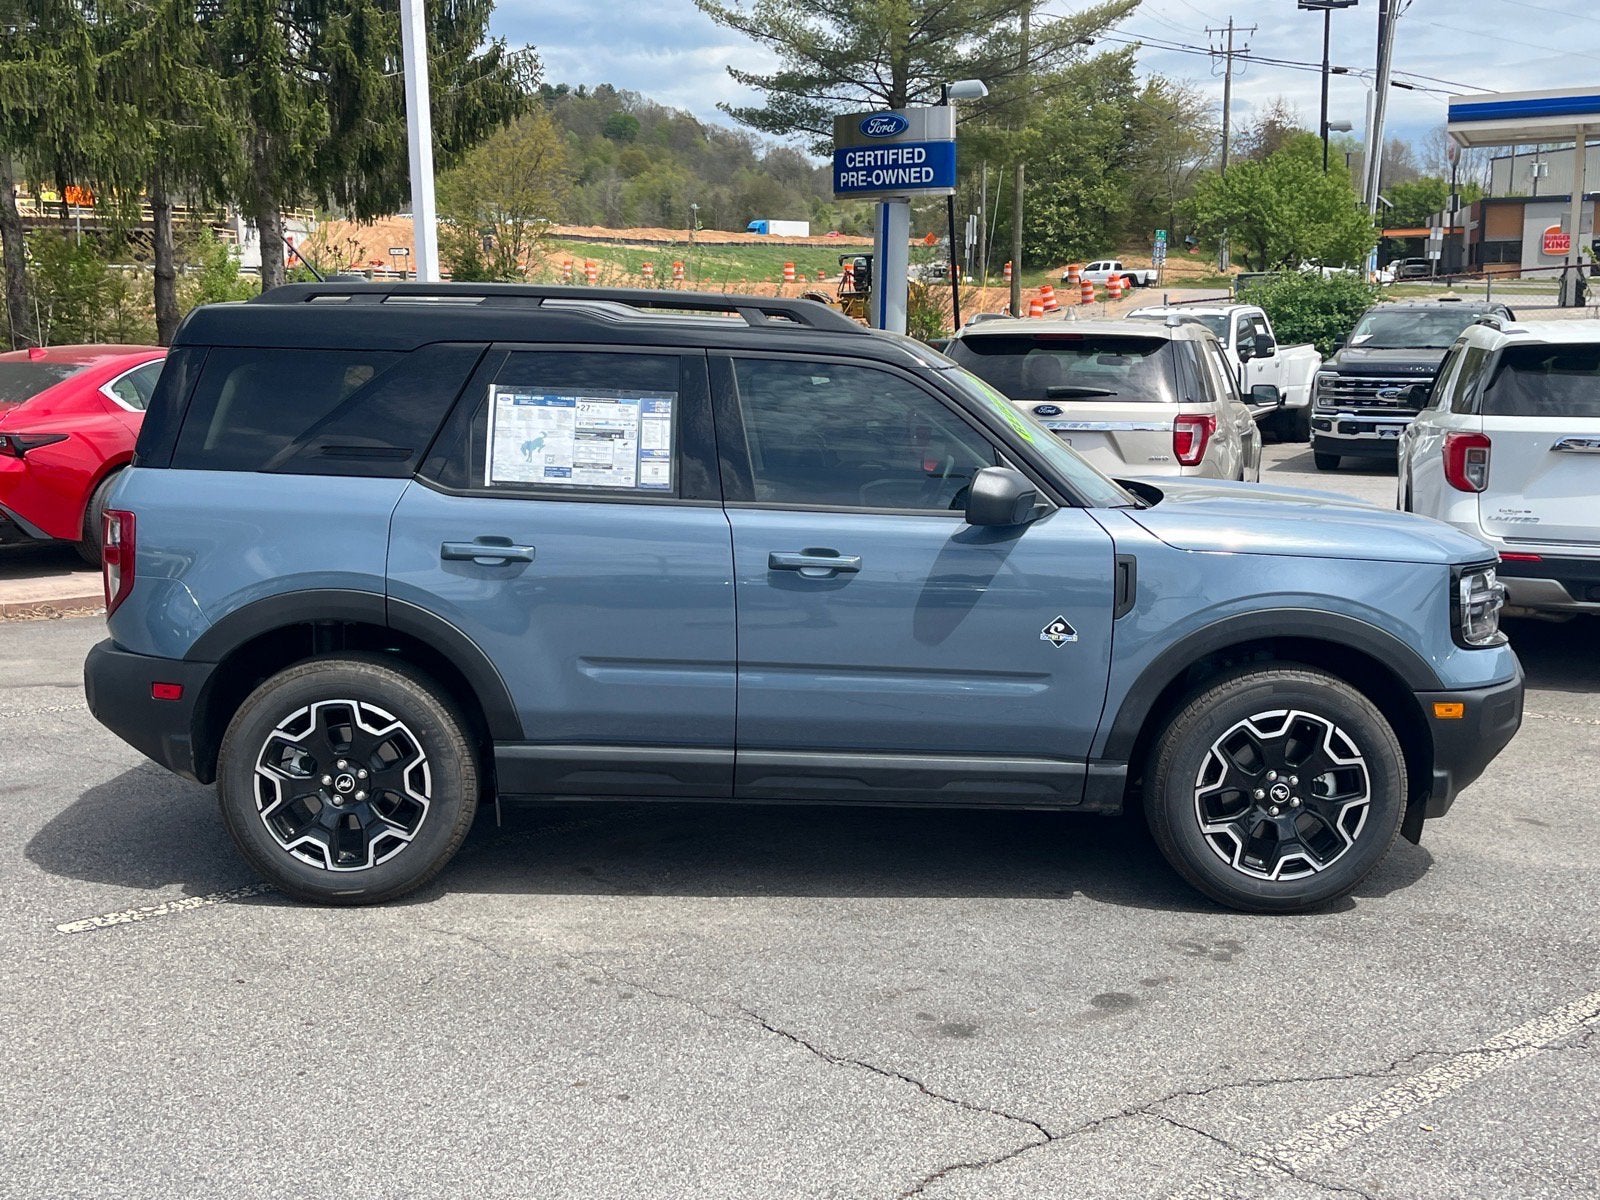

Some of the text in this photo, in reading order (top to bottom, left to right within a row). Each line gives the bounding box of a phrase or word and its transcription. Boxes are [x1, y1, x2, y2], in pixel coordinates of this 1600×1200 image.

[866, 117, 897, 134] Ford
[845, 147, 926, 168] CERTIFIED
[840, 166, 934, 187] PRE-OWNED
[1543, 240, 1570, 249] KING
[580, 404, 591, 412] 27
[1038, 405, 1057, 414] Ford
